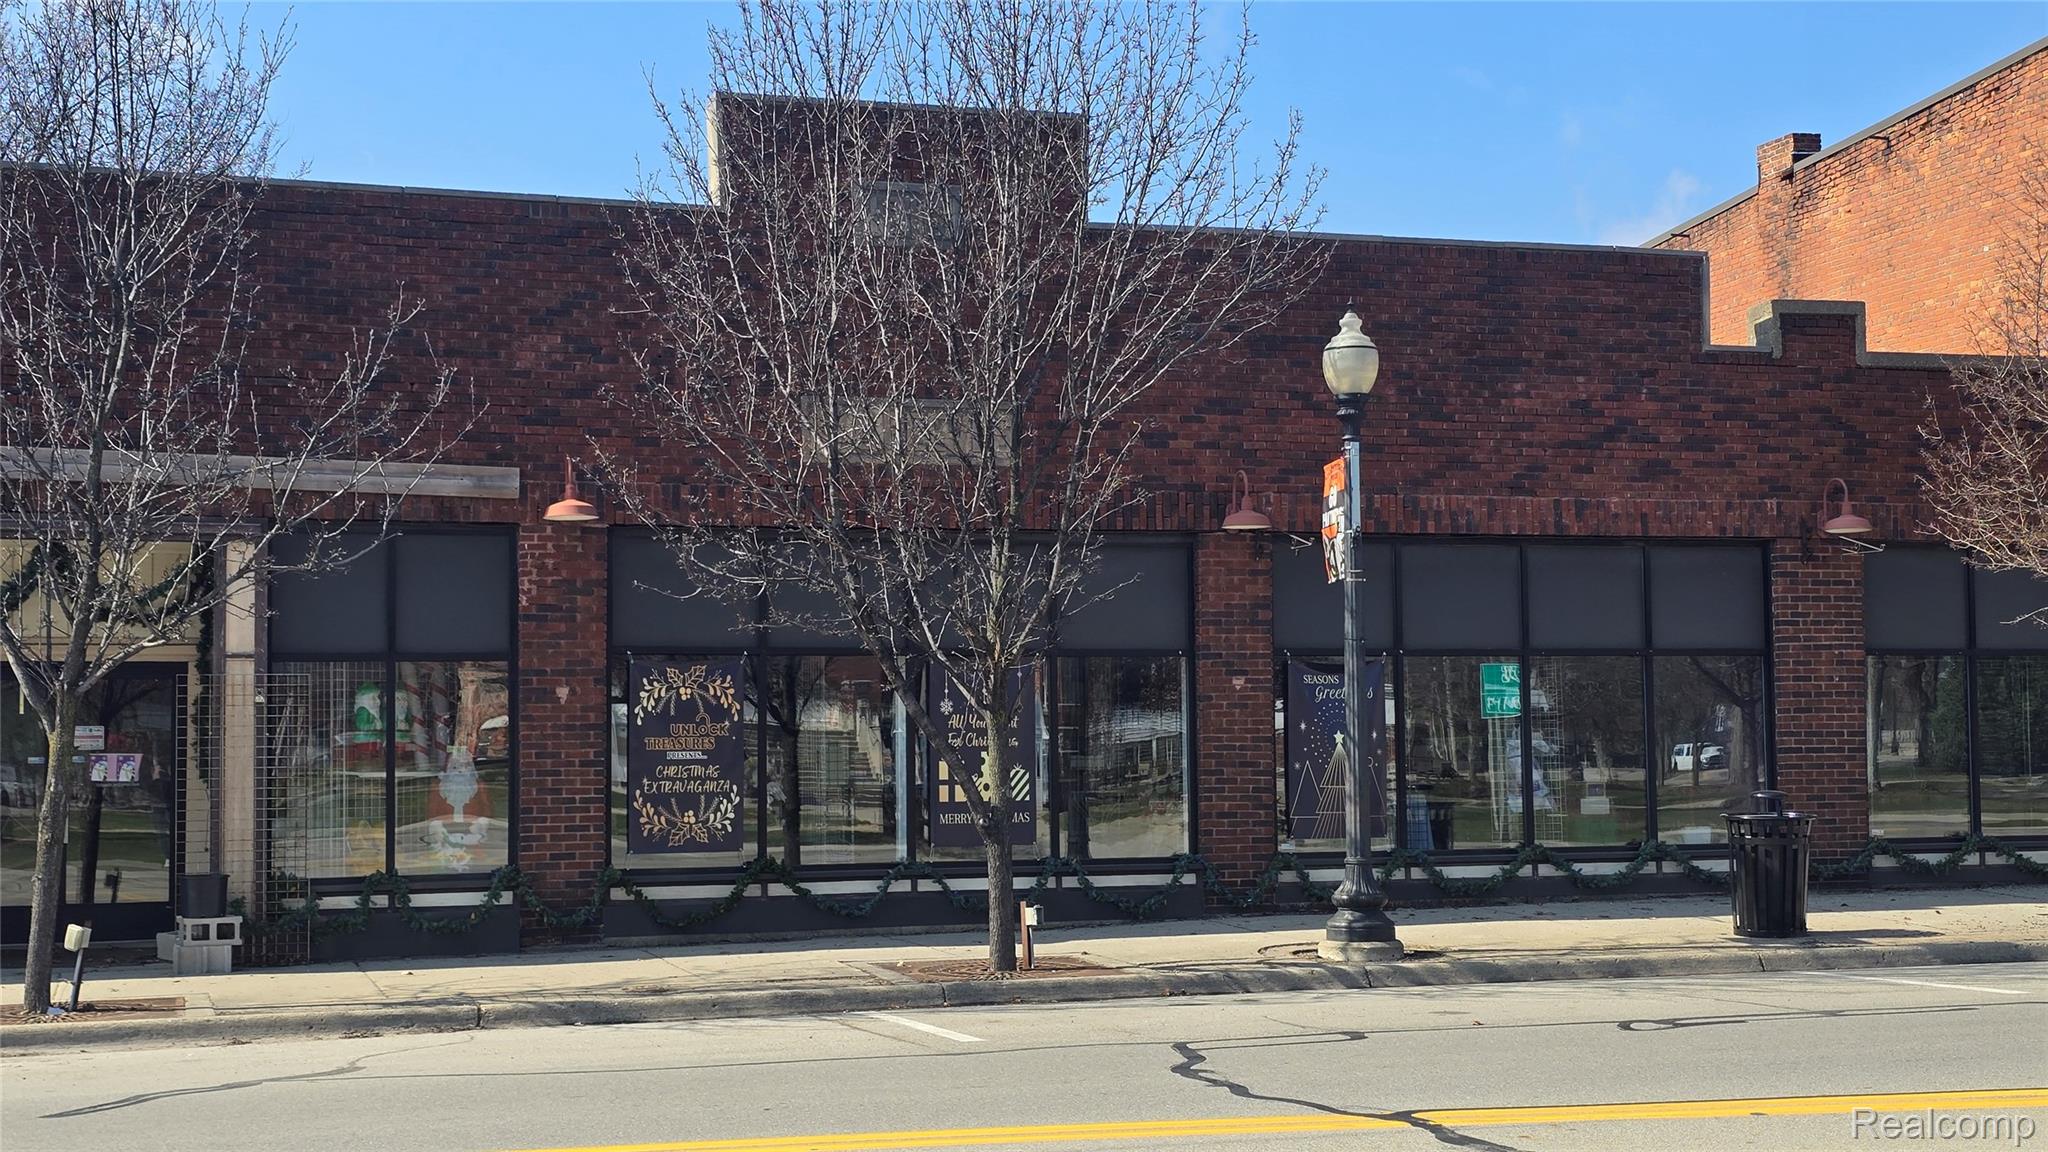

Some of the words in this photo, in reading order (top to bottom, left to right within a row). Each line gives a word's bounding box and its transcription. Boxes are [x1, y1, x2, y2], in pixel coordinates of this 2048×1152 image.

[1303, 674, 1340, 684] SEASONS
[1315, 685, 1374, 703] Greets
[670, 720, 730, 737] UNLOCK
[948, 714, 964, 729] All
[968, 713, 987, 729] You
[644, 737, 716, 750] TREASURES
[655, 764, 721, 779] CHRISTMAS
[644, 779, 731, 795] EXTRAVAGANZA
[940, 813, 973, 825] MERRY
